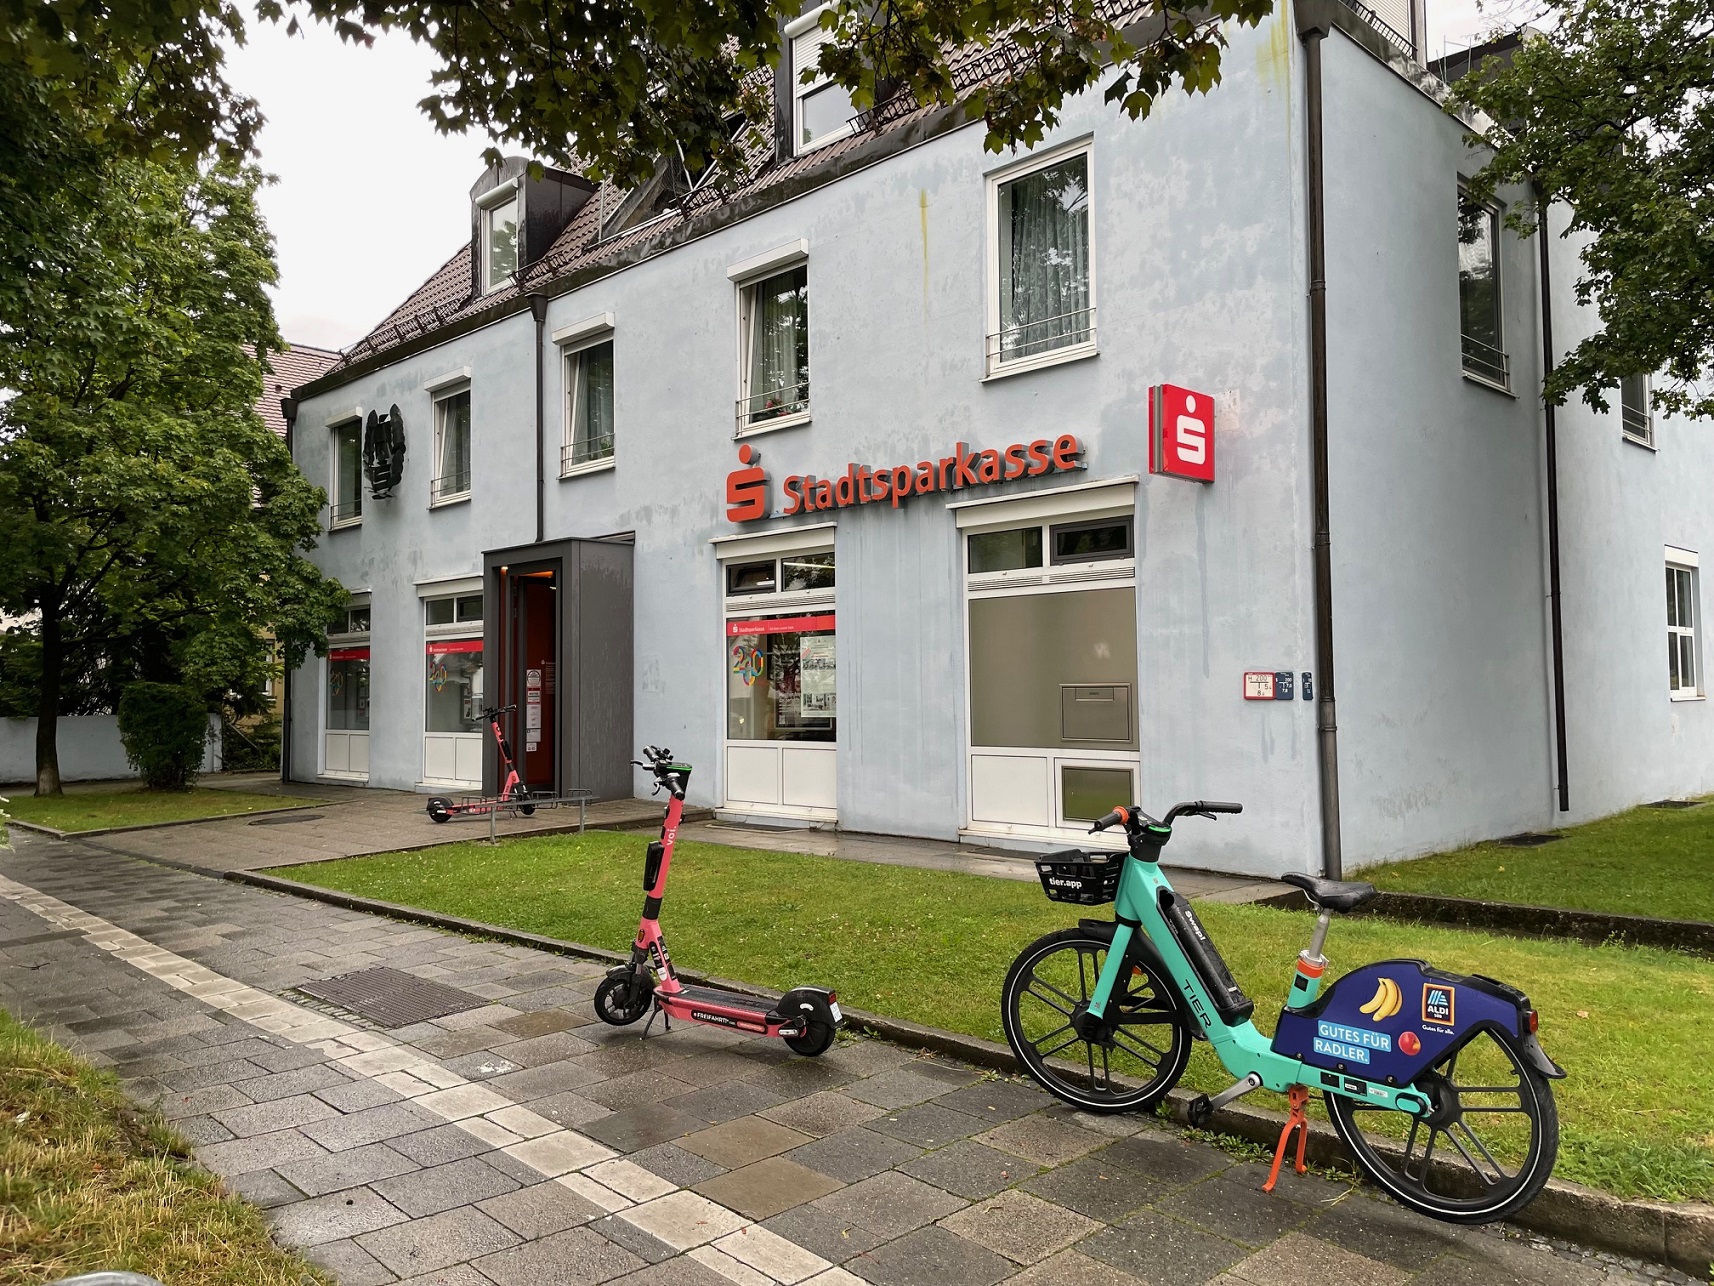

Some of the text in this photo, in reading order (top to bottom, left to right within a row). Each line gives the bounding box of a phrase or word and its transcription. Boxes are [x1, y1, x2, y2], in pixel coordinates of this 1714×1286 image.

[783, 433, 1083, 516] Stadtsparkasse
[1049, 877, 1082, 890] tier.app
[1184, 978, 1212, 1029] TIER
[1427, 1005, 1449, 1015] ALDI
[1320, 1024, 1389, 1049] GUTES FÜR
[1315, 1039, 1368, 1062] RADLER.
